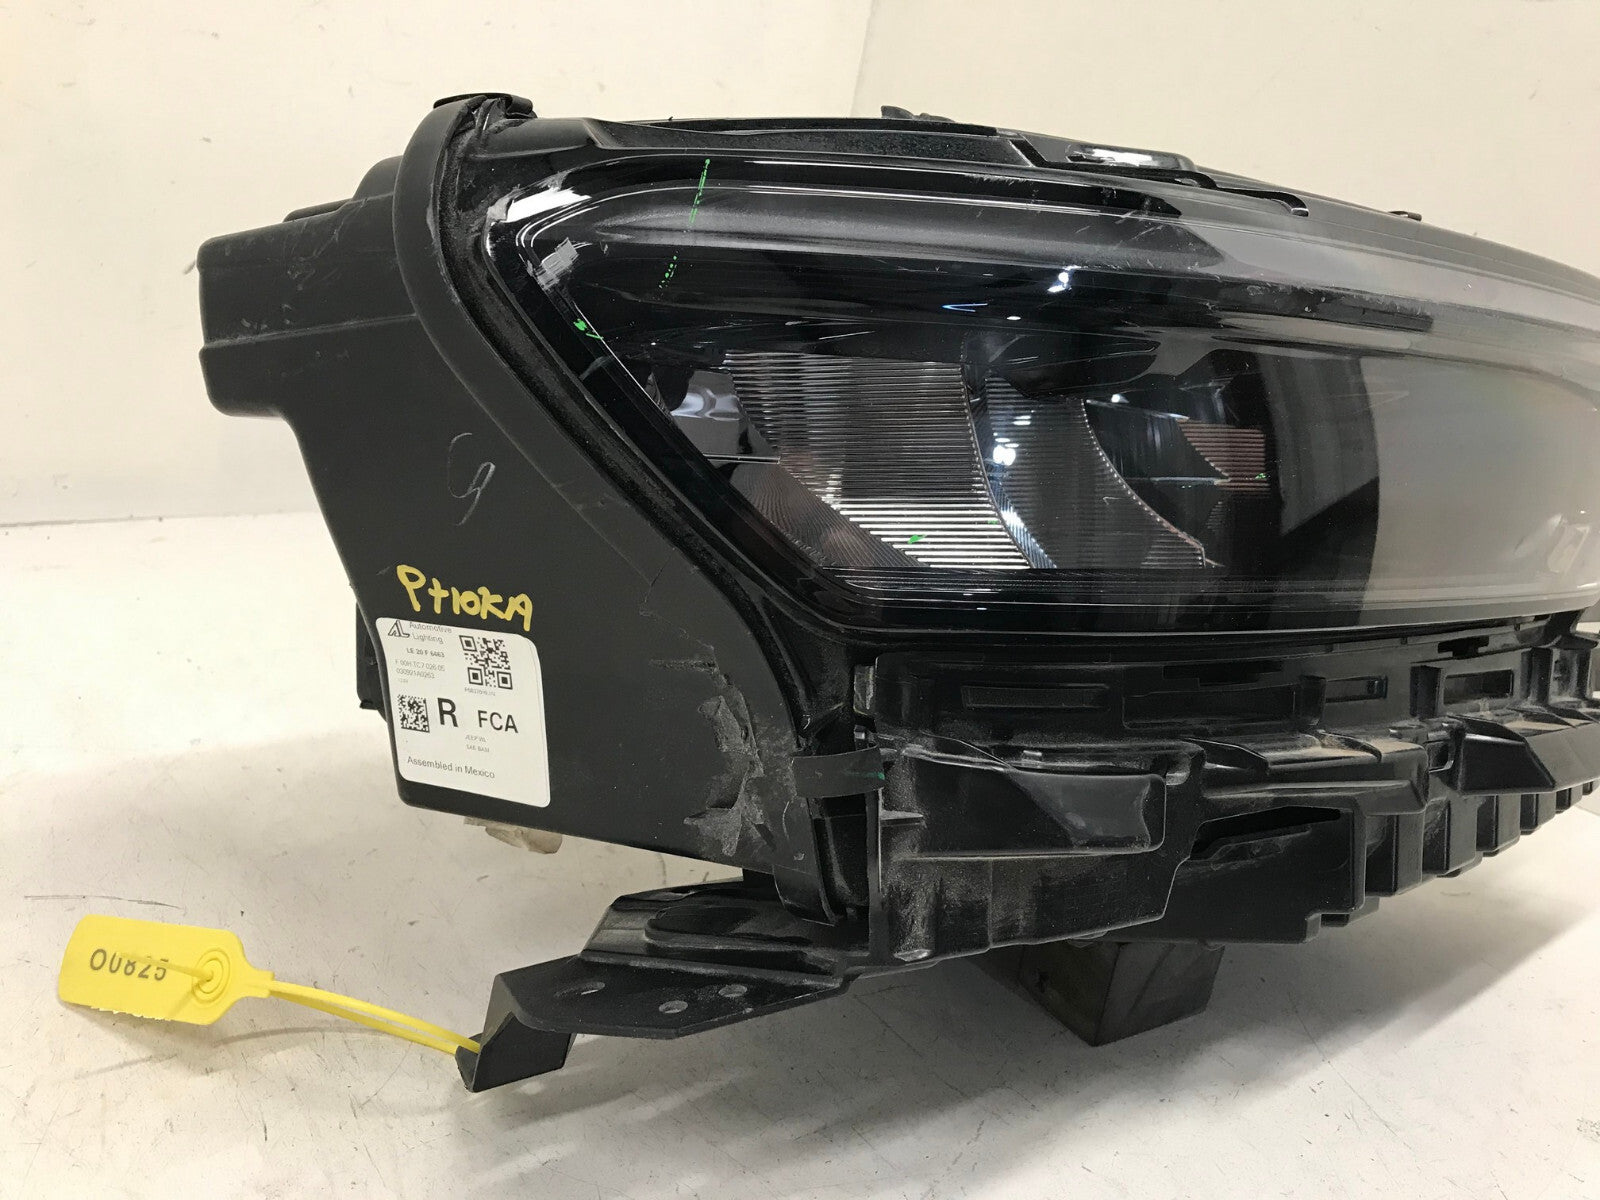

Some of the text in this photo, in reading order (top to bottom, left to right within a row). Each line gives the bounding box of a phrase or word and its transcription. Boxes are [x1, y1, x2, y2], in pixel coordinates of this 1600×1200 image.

[409, 621, 452, 634] Automotive
[412, 633, 444, 645] Lighting
[437, 697, 459, 728] R
[477, 709, 519, 734] FCA
[407, 755, 495, 779] Assembled in Mexico
